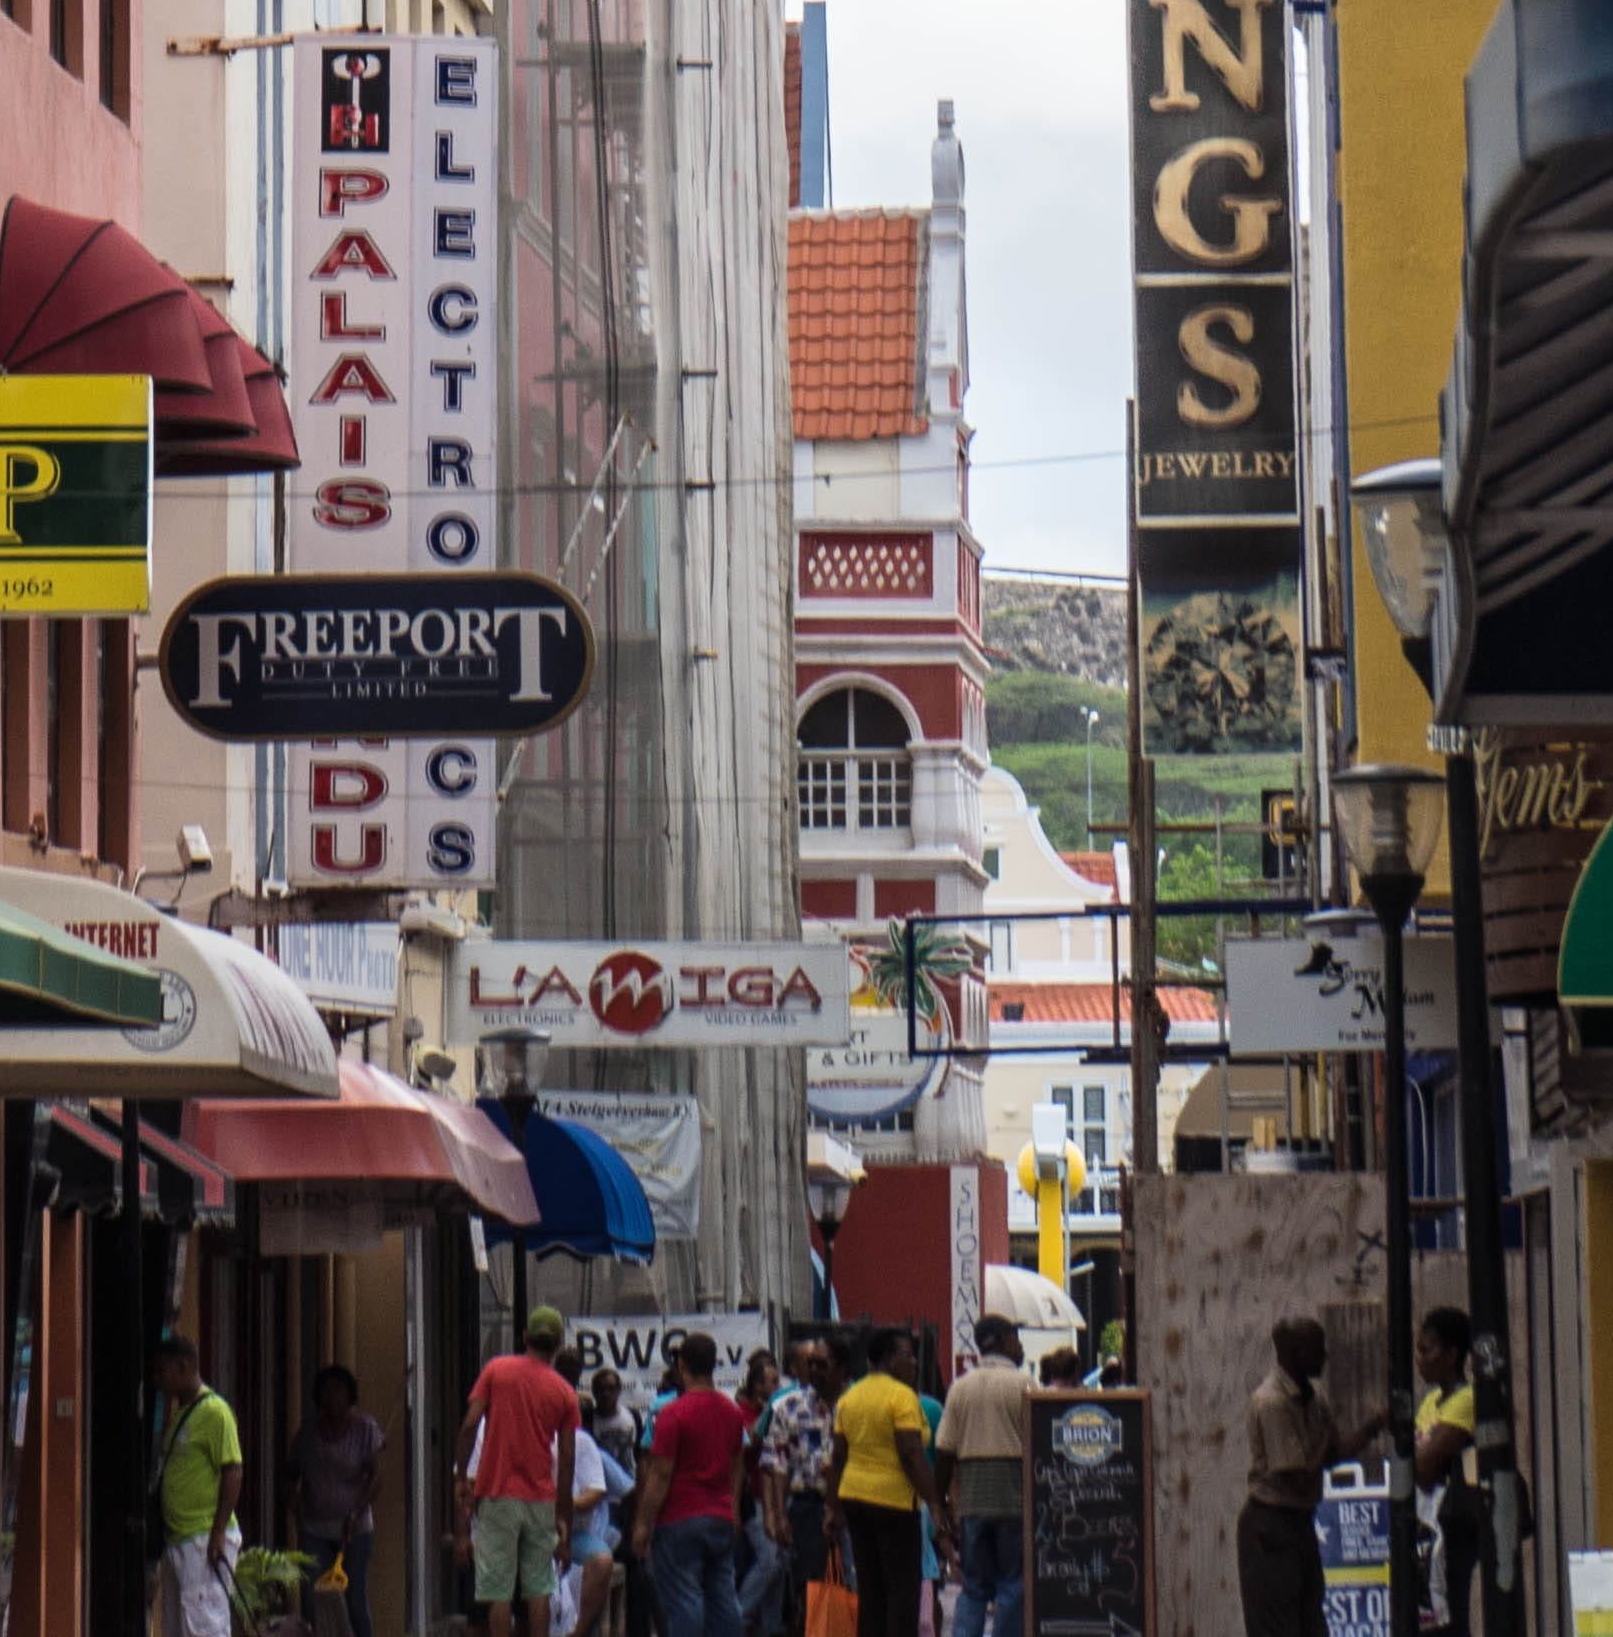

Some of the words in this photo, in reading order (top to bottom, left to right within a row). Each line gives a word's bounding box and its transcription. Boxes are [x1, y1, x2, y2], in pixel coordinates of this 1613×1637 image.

[309, 166, 398, 533] PALAIS
[425, 53, 480, 877] ELECTROCS
[1141, 449, 1295, 486] JEWELRY
[2, 575, 54, 600] 1962
[187, 606, 567, 708] FREEPORT
[261, 660, 365, 681] DUTY
[400, 659, 500, 680] FREE
[331, 683, 428, 700] LIMITED
[483, 1011, 576, 1026] ELECTRONICS
[705, 1011, 745, 1026] VIDEO
[749, 1011, 798, 1027] GAMES
[1062, 1426, 1114, 1444] BRION
